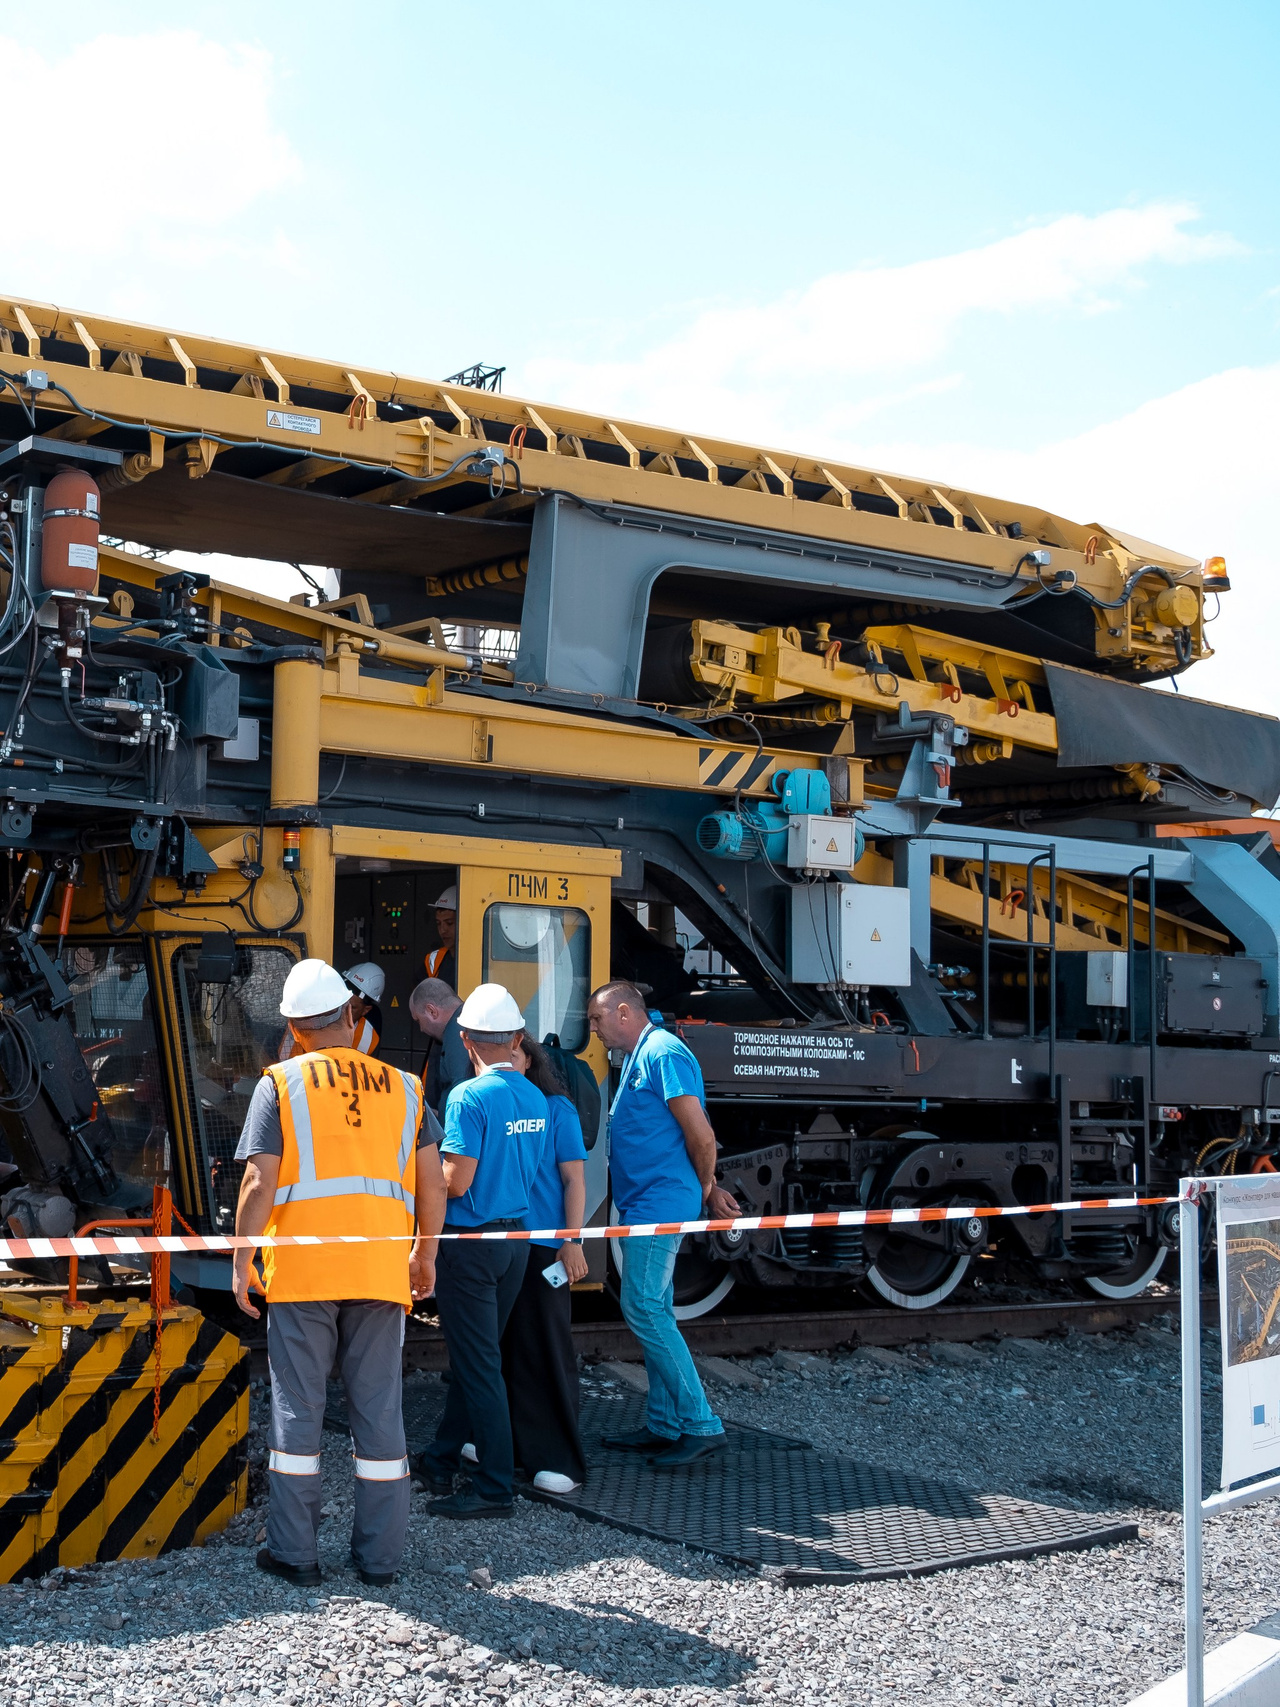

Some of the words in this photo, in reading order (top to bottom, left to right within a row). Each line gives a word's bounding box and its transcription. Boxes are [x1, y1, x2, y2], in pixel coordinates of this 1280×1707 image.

[287, 415, 316, 423] ОСТЕРЕГАЙСЯ
[287, 420, 317, 428] КОНТАКТНОГО
[508, 873, 548, 899] ПЧМ
[557, 877, 569, 900] 3
[734, 1032, 780, 1045] ТОРМОЗНОЕ
[780, 1034, 815, 1046] НАЖАТИЕ
[816, 1036, 827, 1047] НА
[827, 1037, 843, 1048] ОСЬ
[844, 1037, 854, 1048] ТС
[733, 1045, 740, 1056] С
[740, 1045, 803, 1058] КОМПОЗИТНЫМИ
[803, 1048, 848, 1060] КОЛОДКАМИ
[308, 1059, 391, 1093] ПЧМ
[733, 1064, 763, 1076] ОСЕВАЯ
[763, 1065, 799, 1077] НАГРУЗКА
[341, 1092, 361, 1127] 3
